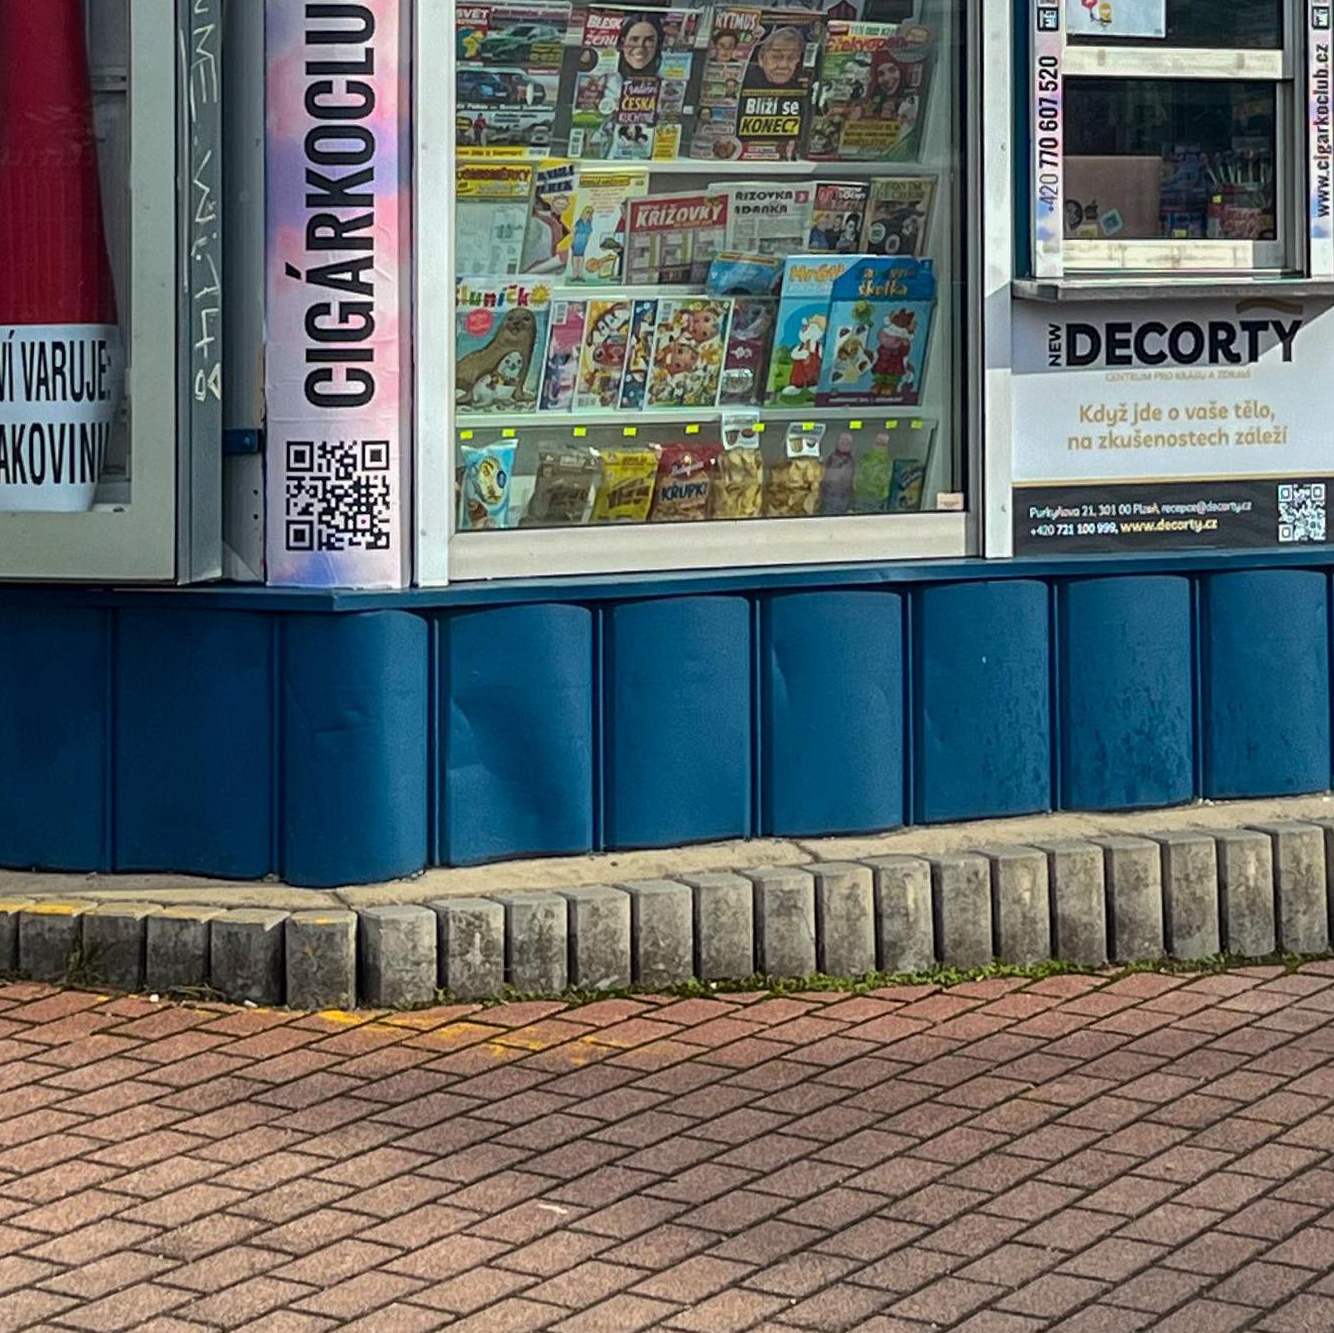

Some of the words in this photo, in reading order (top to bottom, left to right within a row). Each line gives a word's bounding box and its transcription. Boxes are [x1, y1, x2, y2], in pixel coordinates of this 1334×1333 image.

[1038, 55, 1059, 94] 520
[782, 100, 800, 115] se
[1038, 96, 1059, 133] 607
[741, 117, 800, 135] KONEC?
[1313, 42, 1332, 218] www.cigarkoclub.cz
[1038, 135, 1059, 170] 770
[1048, 322, 1062, 367] NEW
[1065, 319, 1303, 366] DECORTY
[1078, 401, 1129, 428] Když
[1129, 402, 1163, 427] jde
[1167, 407, 1179, 421] o
[1185, 400, 1229, 421] vaše
[1234, 398, 1276, 424] tělo,
[1067, 435, 1092, 451] na
[1098, 426, 1230, 450] zkušenostech
[1234, 424, 1289, 446] záleží
[1077, 522, 1096, 535] 100
[1120, 518, 1219, 534] www.decorty.cz
